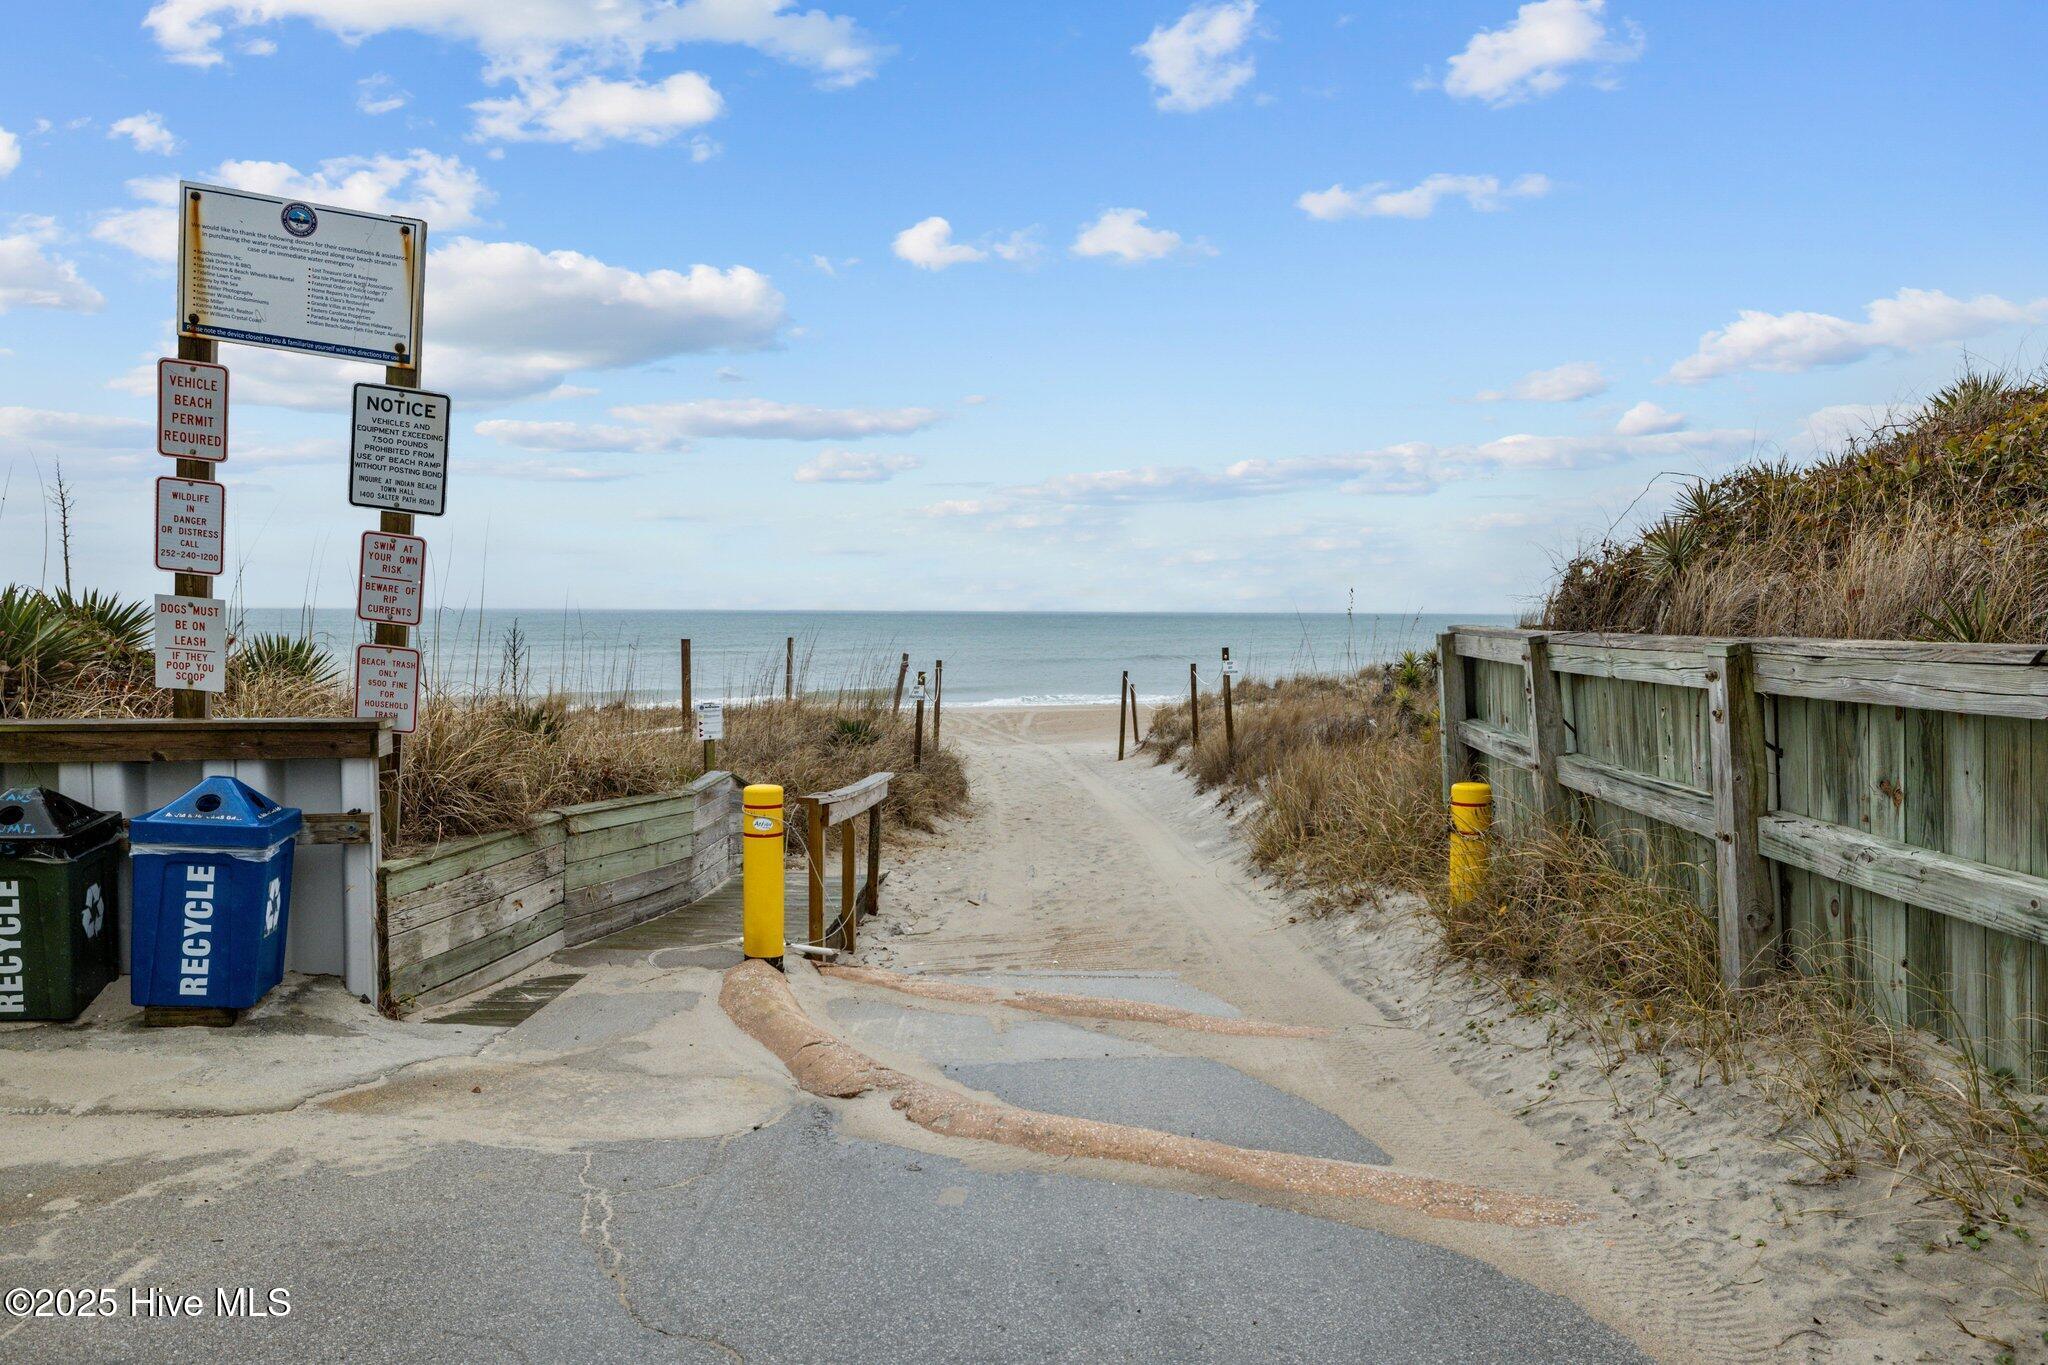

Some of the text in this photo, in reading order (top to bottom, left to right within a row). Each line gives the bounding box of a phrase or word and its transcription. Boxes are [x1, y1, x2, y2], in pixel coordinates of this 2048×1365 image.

[209, 234, 240, 243] purchasing
[311, 248, 329, 256] placed
[330, 251, 345, 260] along
[357, 255, 373, 263] beach
[221, 226, 230, 234] like
[268, 234, 294, 244] following
[339, 246, 374, 256] contributions
[381, 253, 408, 261] assistance
[277, 251, 306, 260] immediate
[325, 259, 354, 268] emergency
[227, 331, 244, 339] device
[315, 343, 336, 352] yourself
[358, 350, 381, 359] directions
[169, 375, 218, 391] VEHICLE
[175, 395, 212, 409] BEACH
[367, 396, 436, 419] NOTICE
[172, 413, 214, 427] PERMIT
[372, 417, 410, 428] VEHICLES
[165, 430, 221, 447] REQUIRED
[357, 425, 443, 442] EQUIPMENT EXCEEDING
[396, 439, 428, 449] POUNDS
[365, 445, 435, 459] PROHIBITED FROM
[389, 457, 415, 465] BEACH
[419, 461, 441, 469] RAMP
[355, 461, 443, 479] WITHOUT POSTING BOND
[359, 475, 382, 483] INQUIRE
[395, 480, 415, 488] INDIAN
[172, 492, 210, 503] WILDLIFE
[400, 488, 415, 496] HALL
[378, 493, 399, 502] SALTER
[402, 496, 416, 504] PATH
[187, 505, 195, 513] IN
[174, 515, 207, 526] DANGER
[162, 526, 219, 538] OR DISTRESS
[181, 540, 199, 548] CALL
[374, 542, 396, 551] SWIM
[161, 549, 219, 561] 252-240-1200
[369, 552, 418, 565] YOUR OWN
[383, 565, 402, 574] RISK
[366, 582, 416, 596] BEWARE OF
[384, 595, 397, 603] RIP
[161, 603, 219, 617] DOGS MUST
[368, 605, 412, 617] CURRENTS
[176, 620, 205, 631] BE ON
[175, 636, 206, 647] LEASH
[173, 652, 208, 662] IF THEY
[167, 662, 214, 672] POOP YOU
[362, 658, 416, 669] BEACH TRASH
[176, 672, 205, 681] SCOOP
[379, 670, 398, 678] ONLY
[368, 679, 387, 687] $500
[365, 700, 408, 710] HOUSEHOLD
[375, 711, 399, 719] TRASH
[180, 865, 215, 996] RECYCLE
[0, 880, 24, 1013] RECYCLE
